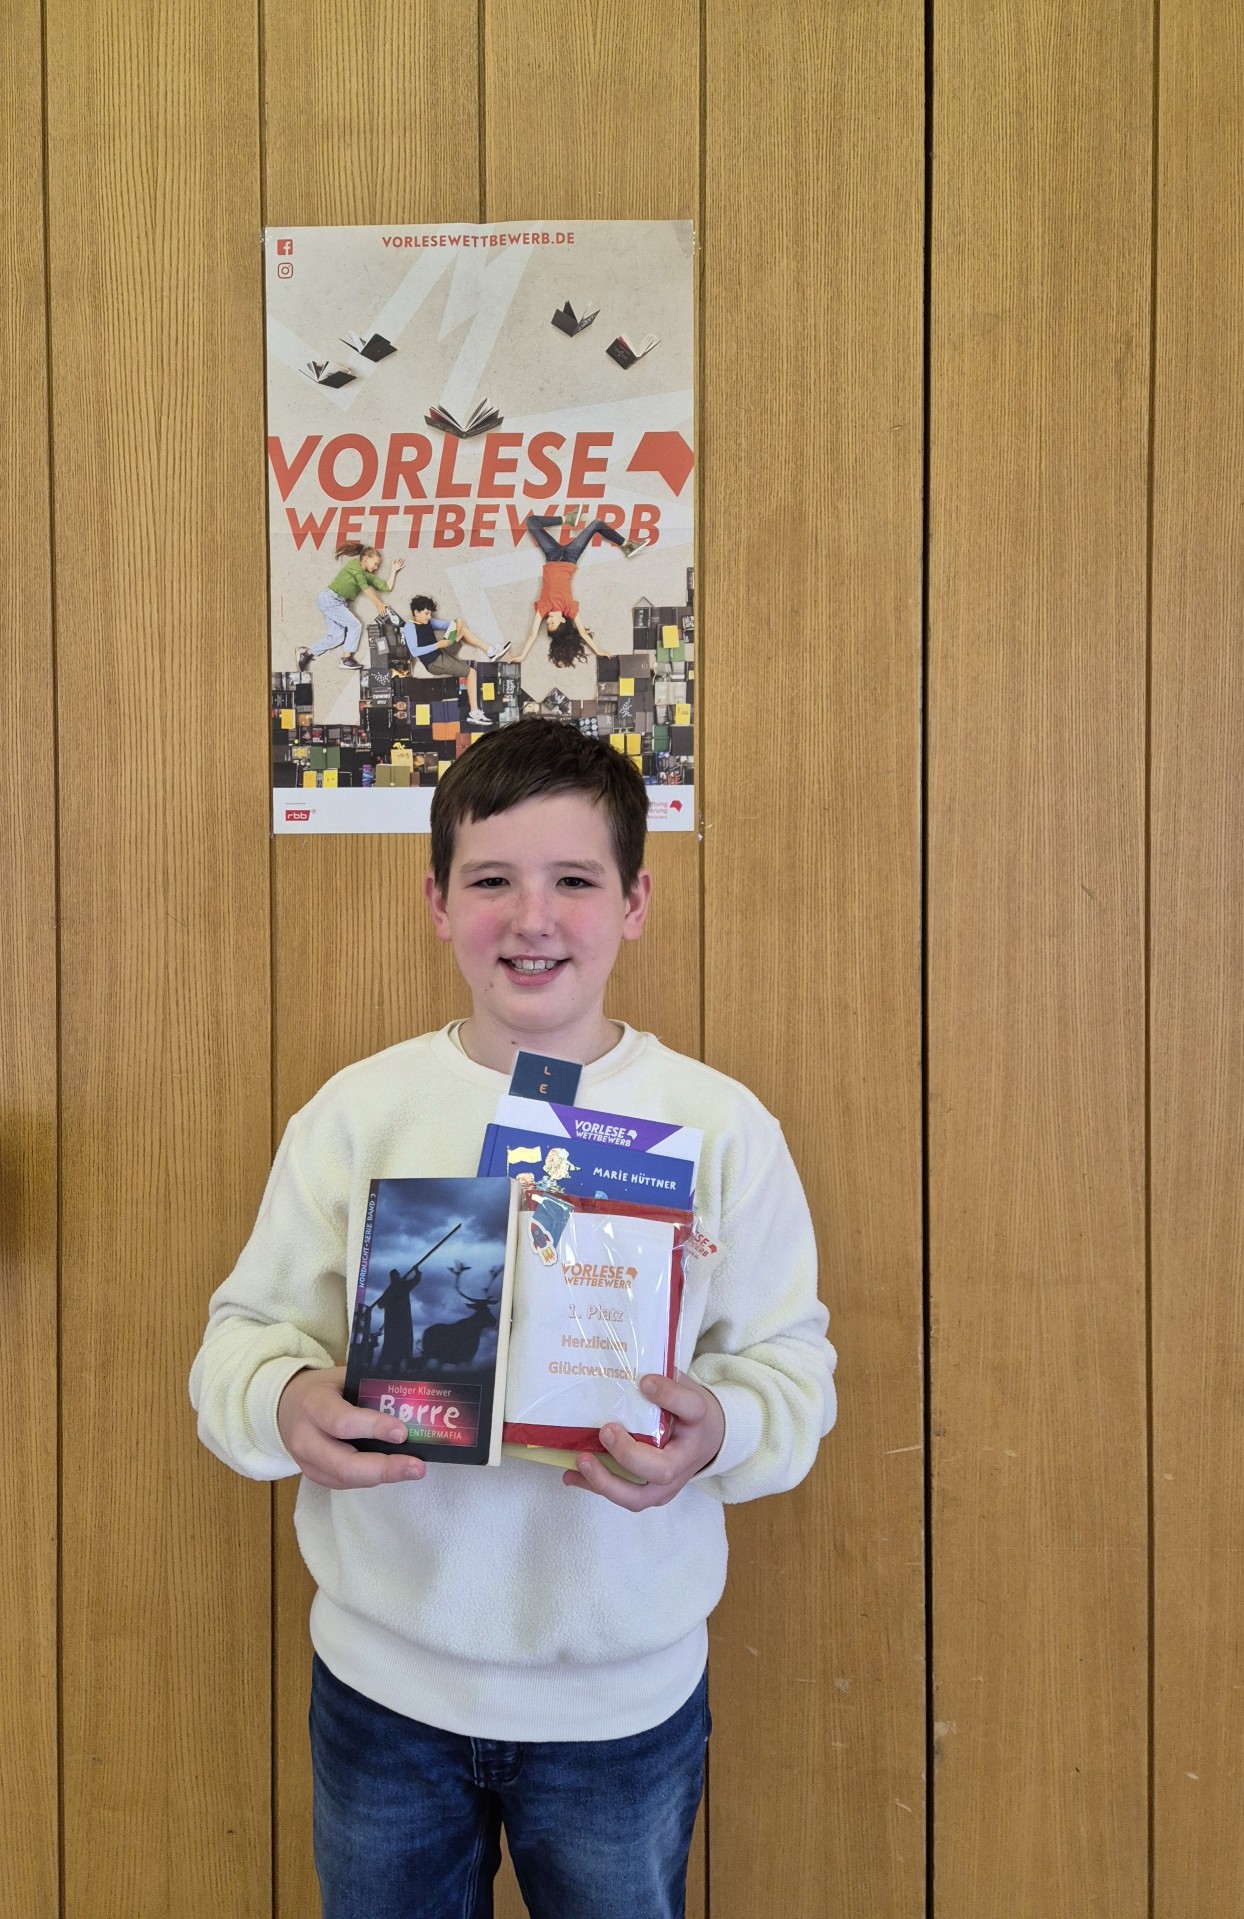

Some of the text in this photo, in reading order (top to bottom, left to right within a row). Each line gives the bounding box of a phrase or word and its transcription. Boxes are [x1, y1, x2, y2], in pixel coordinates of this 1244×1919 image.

[381, 232, 575, 248] VORLESEWETTBEWERB.DE
[267, 431, 615, 502] VORLESE
[287, 811, 308, 820] rbb
[575, 1119, 627, 1138] VORLESE
[576, 1130, 632, 1147] WETTBEWERB
[631, 1172, 677, 1190] HÜTTNER
[561, 1261, 625, 1279] VORLESE
[564, 1275, 632, 1290] WETTBEWERB
[568, 1303, 625, 1322] 1. Platz
[387, 1384, 452, 1397] Holger Klaewer
[379, 1394, 460, 1429] Børre
[409, 1428, 462, 1440] ENTIERMAFIA
